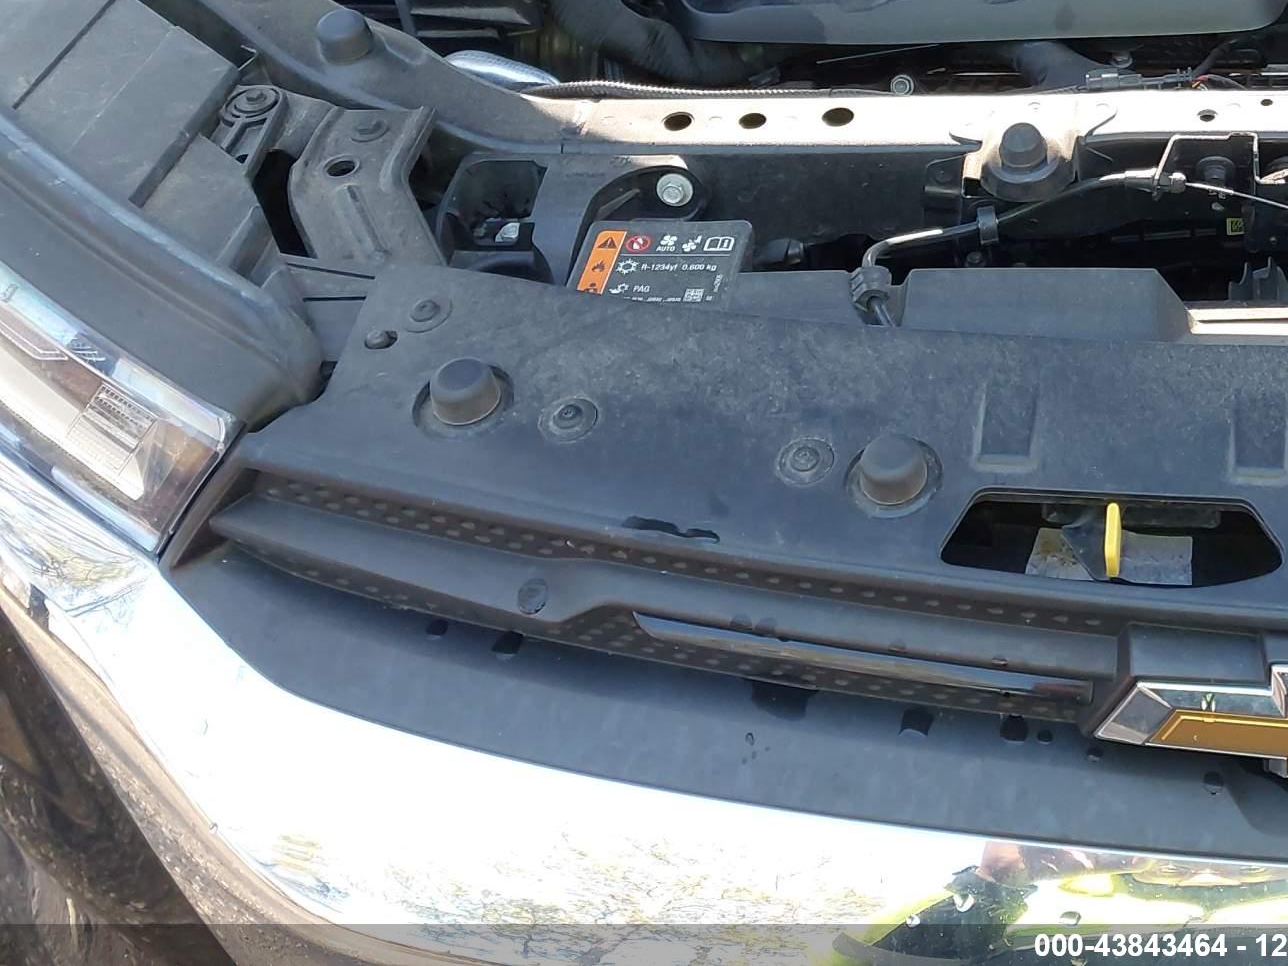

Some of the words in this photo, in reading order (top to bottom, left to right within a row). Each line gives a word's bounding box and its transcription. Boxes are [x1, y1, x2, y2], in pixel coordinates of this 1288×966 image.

[640, 263, 678, 272] R-1234yf
[706, 263, 717, 272] kg
[632, 285, 651, 293] PAG
